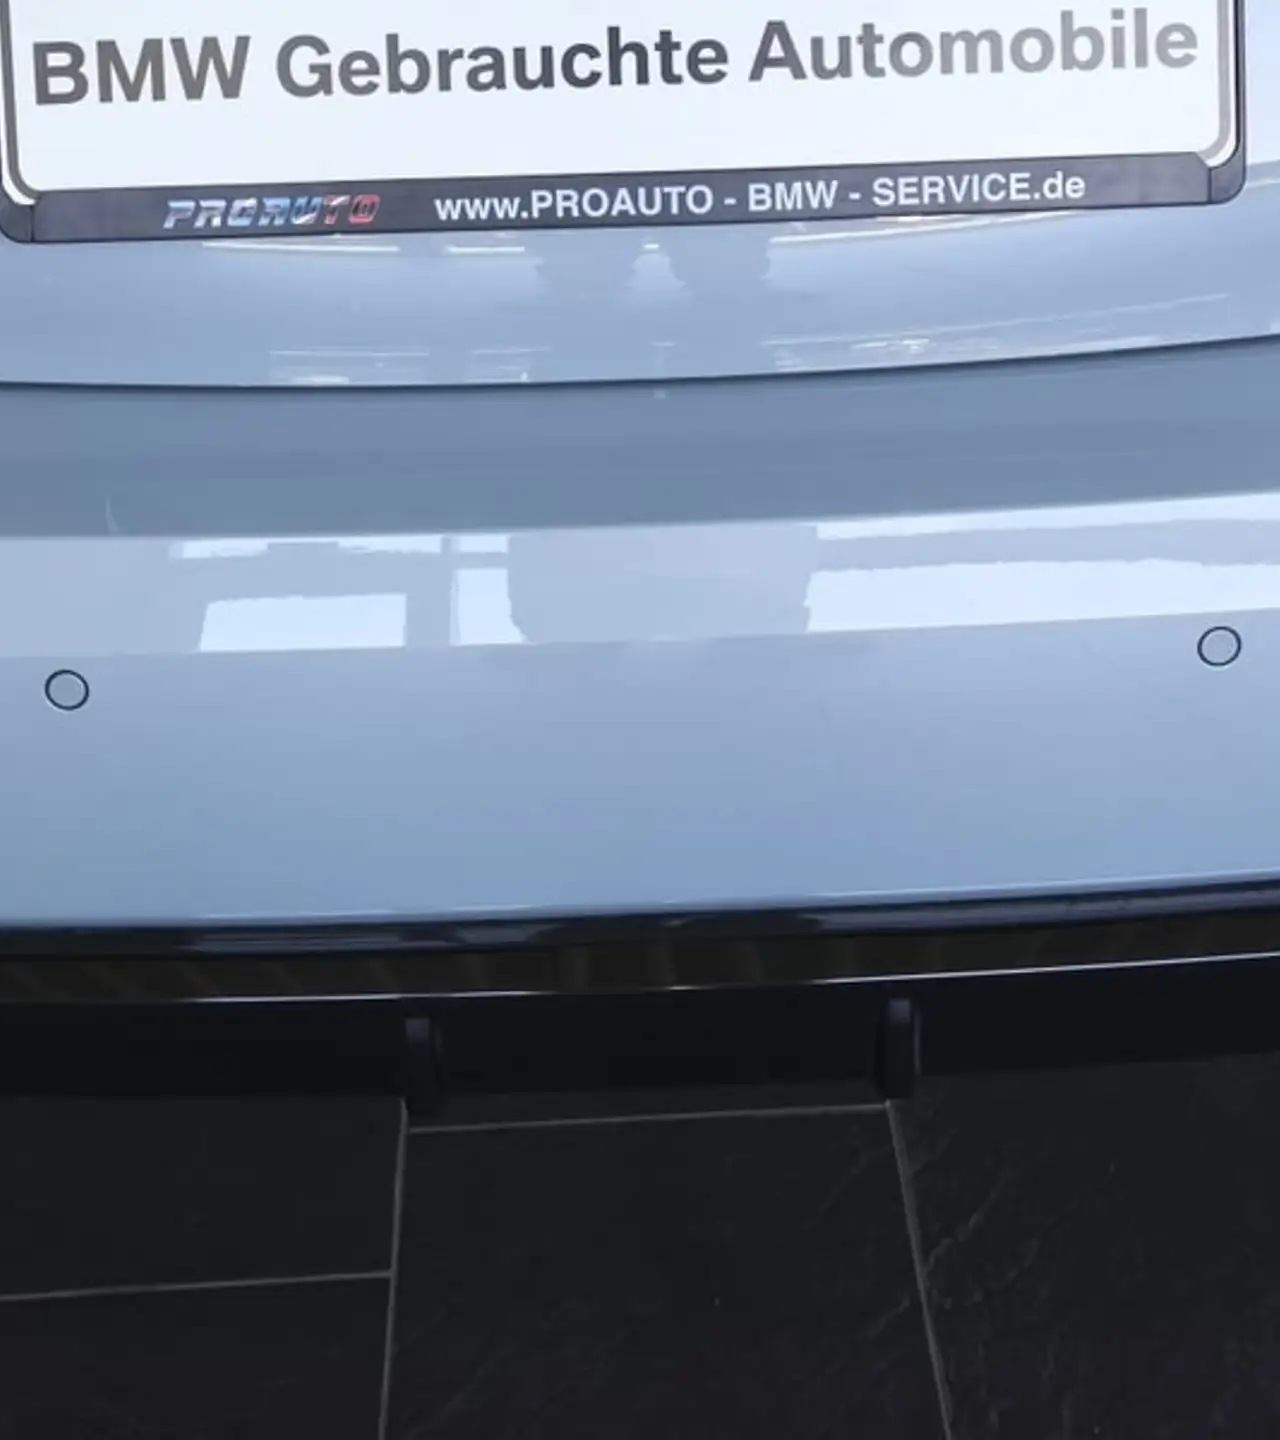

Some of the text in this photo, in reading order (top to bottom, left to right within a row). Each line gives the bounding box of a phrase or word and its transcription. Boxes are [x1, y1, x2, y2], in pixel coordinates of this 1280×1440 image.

[32, 6, 1198, 105] BMW Gebrauchte Automobile
[163, 193, 381, 229] PROAUTO
